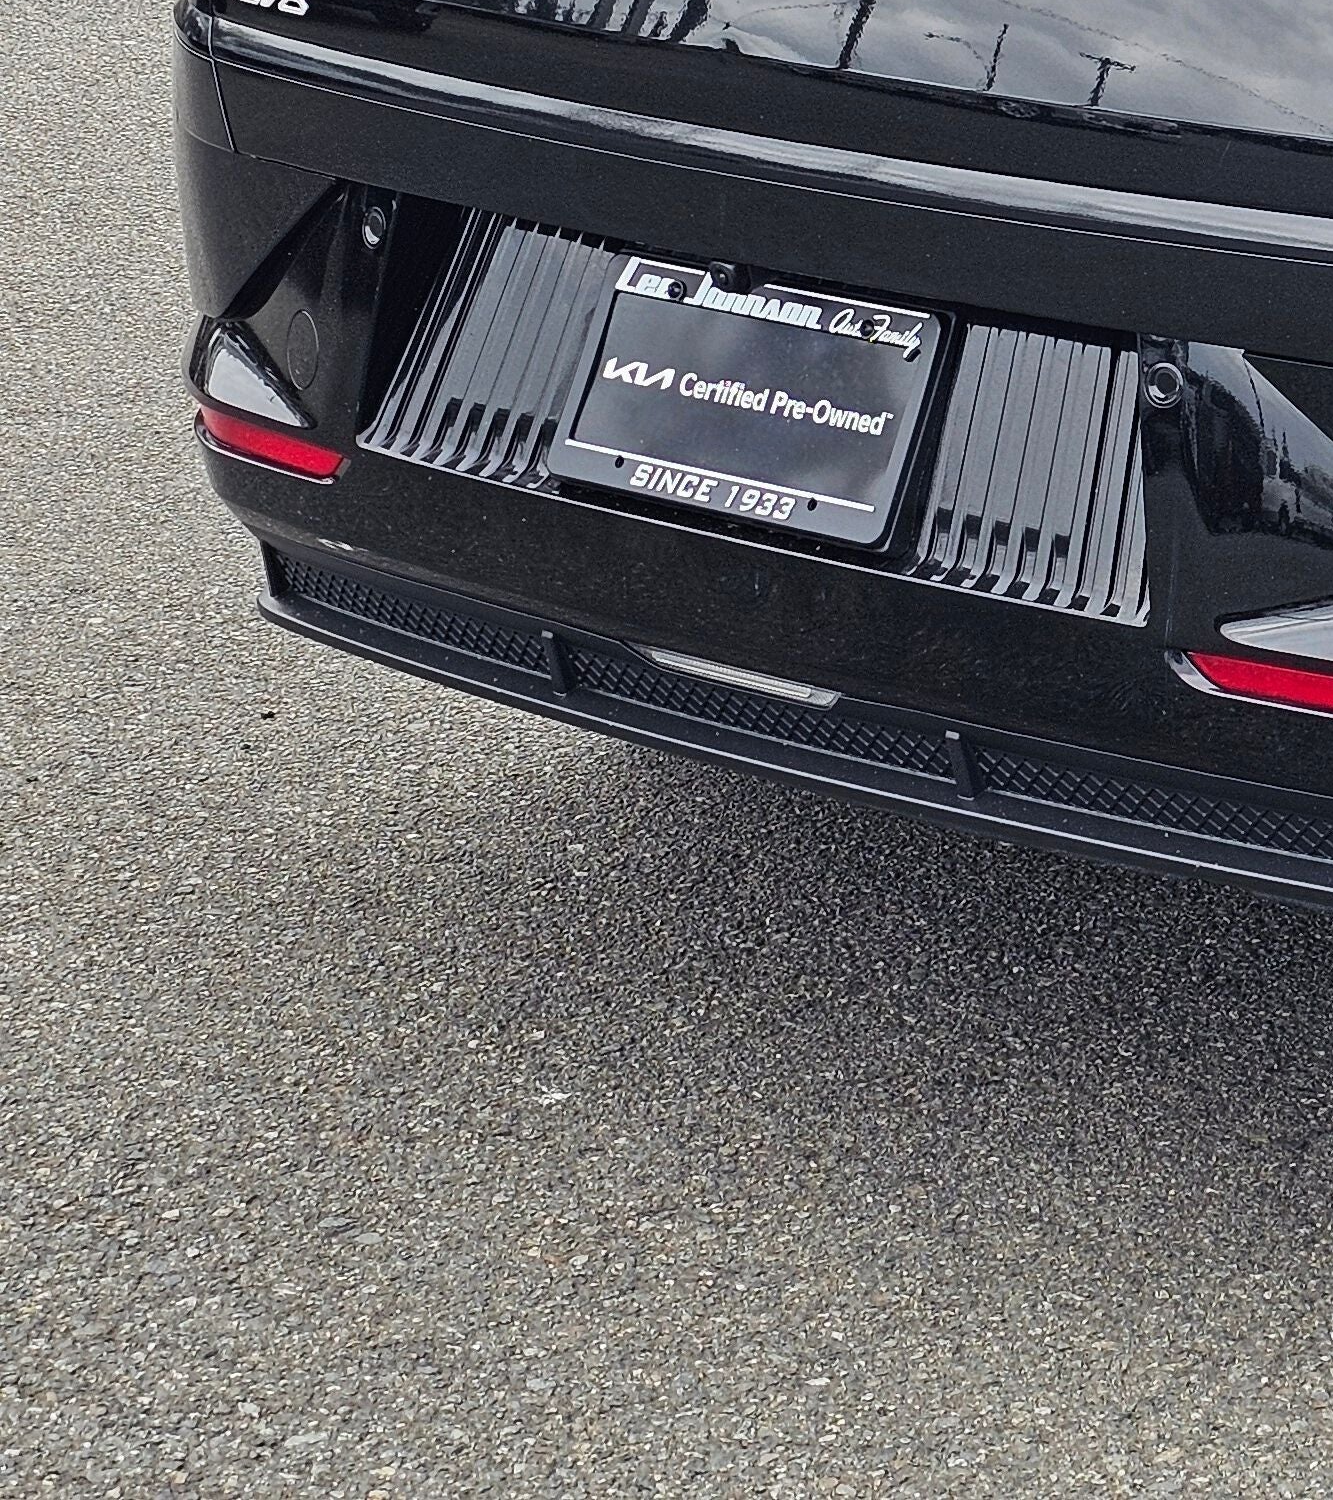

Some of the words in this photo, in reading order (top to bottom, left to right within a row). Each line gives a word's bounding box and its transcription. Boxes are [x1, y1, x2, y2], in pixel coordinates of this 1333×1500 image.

[828, 308, 872, 338] Aut
[872, 313, 924, 358] Family
[602, 357, 676, 390] KIA
[679, 372, 771, 412] Certified
[629, 463, 719, 504] SINCE
[724, 484, 797, 521] 1933
